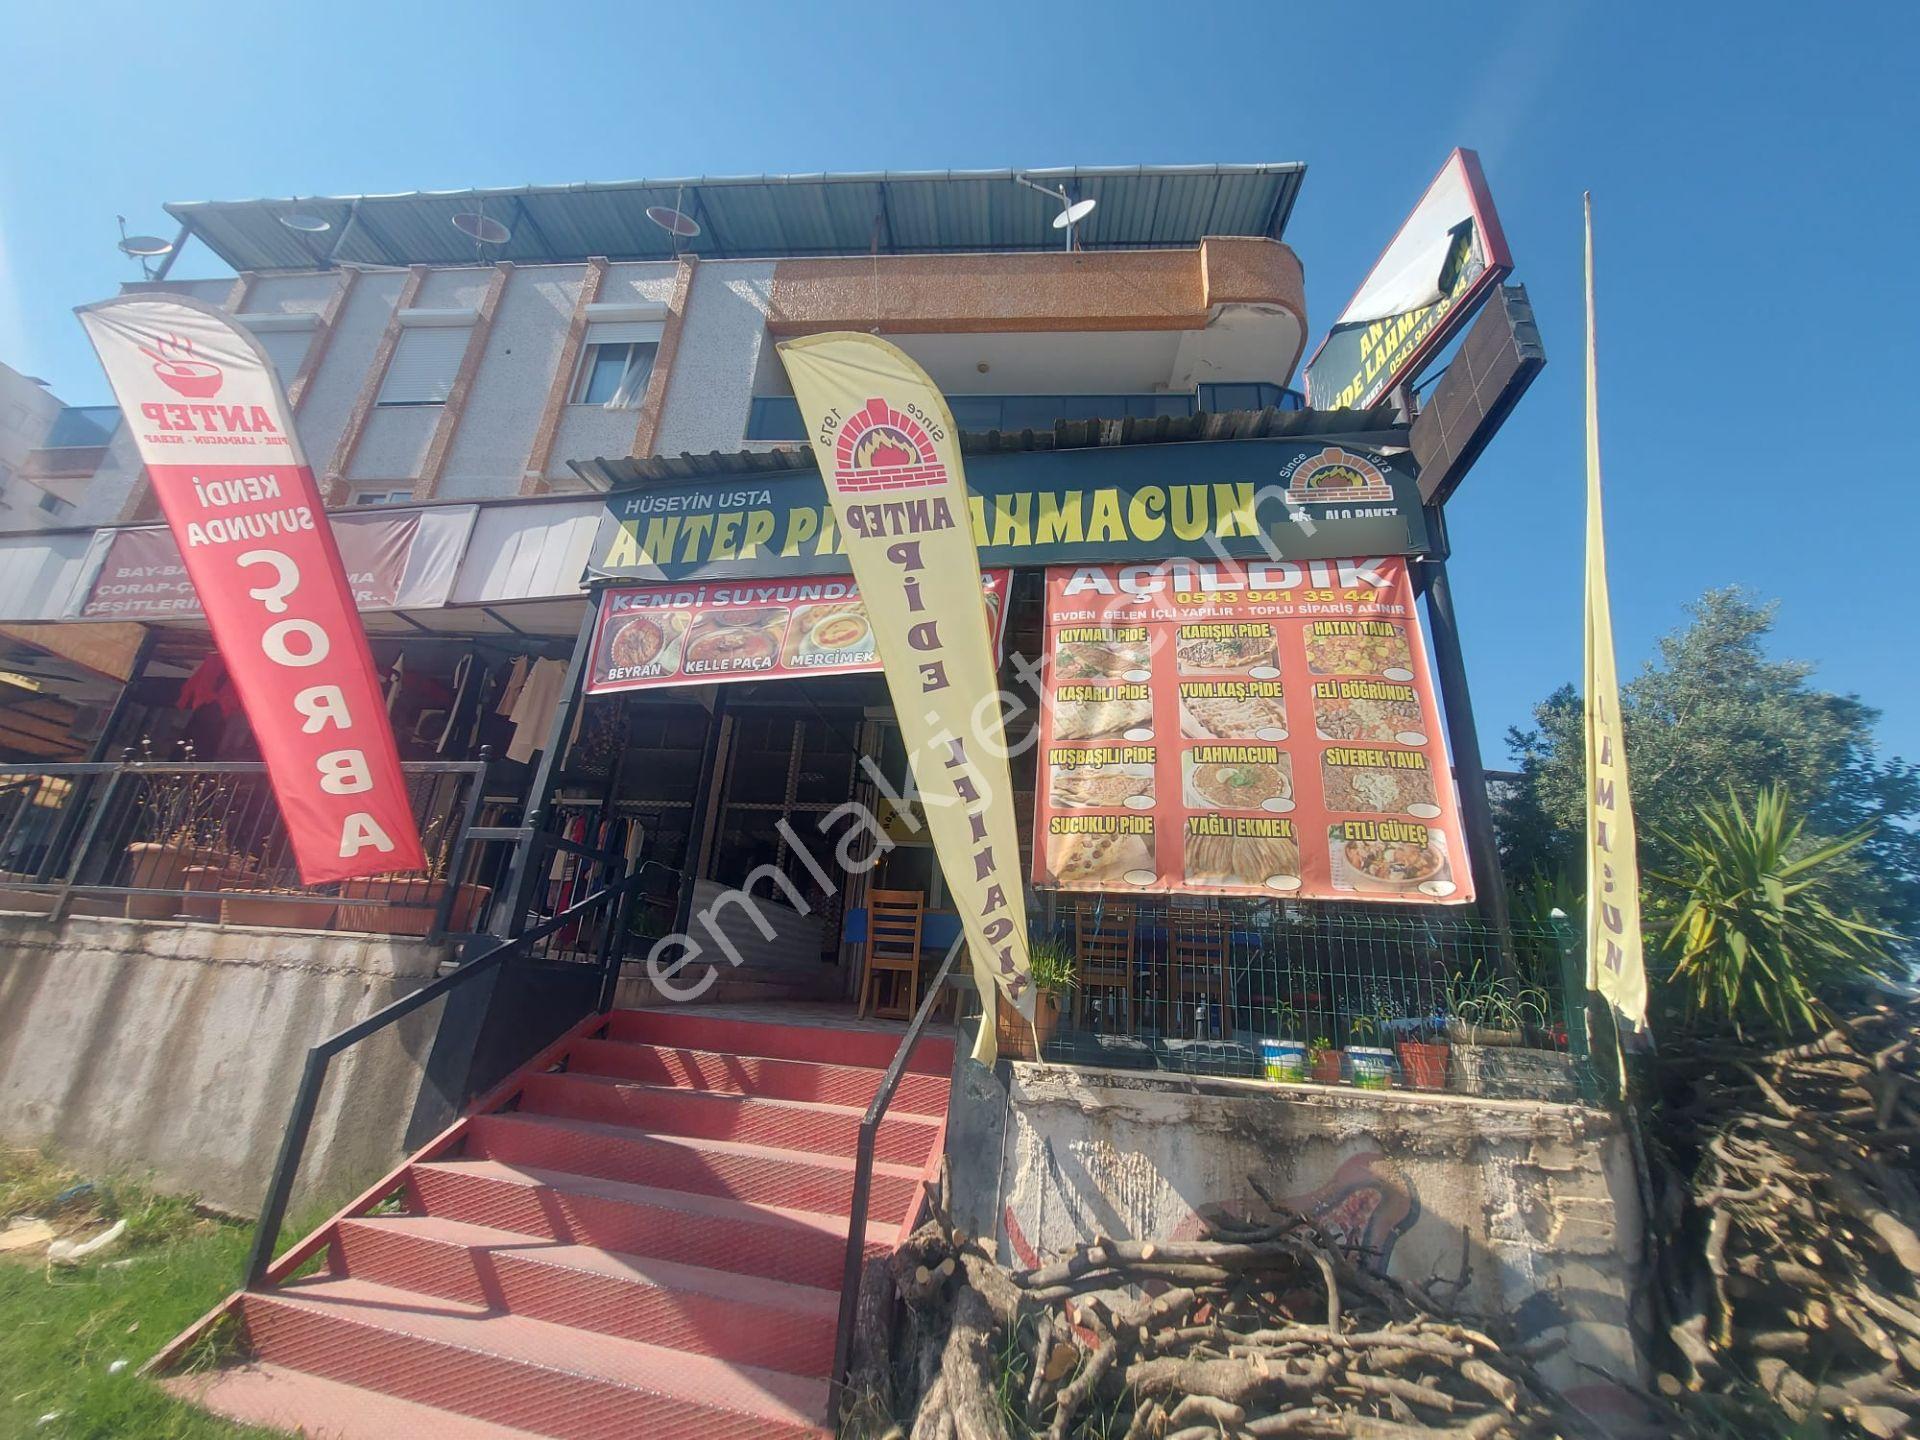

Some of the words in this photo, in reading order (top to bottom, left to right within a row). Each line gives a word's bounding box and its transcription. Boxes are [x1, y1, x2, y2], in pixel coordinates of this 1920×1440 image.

[1435, 299, 1451, 319] 35
[1280, 453, 1307, 478] Since
[1366, 453, 1392, 473] 1973
[625, 492, 712, 514] HÜSEYİN
[718, 490, 772, 508] USTA
[603, 509, 775, 568] ANTEP
[967, 483, 1259, 548] AHMACUN
[1063, 559, 1394, 603] AÇILDIK
[612, 587, 707, 611] KENDİ
[1176, 591, 1239, 604] 0543
[1247, 591, 1292, 603] 941
[1304, 591, 1335, 602] 35
[1344, 590, 1376, 602] 44
[1053, 611, 1095, 621] EVDEN
[1104, 610, 1147, 620] GELEN
[1181, 607, 1233, 617] YAPILIR
[1248, 606, 1293, 616] TOPLU
[1300, 603, 1353, 615] SİPARİŞ
[1359, 604, 1406, 615] ALINIR
[1060, 628, 1114, 643] KIYMALI
[1116, 626, 1147, 642] PİDE
[1181, 624, 1236, 642] KARIŞIK
[1238, 623, 1270, 638] PİDE
[1314, 621, 1358, 636] HATAY
[1359, 621, 1395, 636] TAVA
[686, 658, 728, 673] KELLE
[733, 656, 772, 671] PAÇA
[791, 648, 875, 666] MERCİMEK
[608, 664, 661, 681] BEYRAN
[1058, 685, 1114, 704] KAŞARLI
[1116, 684, 1148, 700] PİDE
[1316, 680, 1338, 699] ELİ
[1340, 681, 1414, 701] BÖĞRÜNDE
[1049, 748, 1120, 769] KUŞBAŞILI
[1122, 746, 1156, 764] PİDE
[1193, 747, 1278, 764] LAHMACUN
[1326, 748, 1387, 767] SİVEREK
[1387, 751, 1425, 769] TAVA
[1050, 816, 1117, 834] SUCUKLU
[1119, 815, 1155, 834] PİDE
[1189, 814, 1232, 836] YAĞLI
[1236, 819, 1292, 837] EKMEK
[1345, 820, 1376, 841] ETLİ
[1379, 821, 1428, 847] GÜVEÇ
